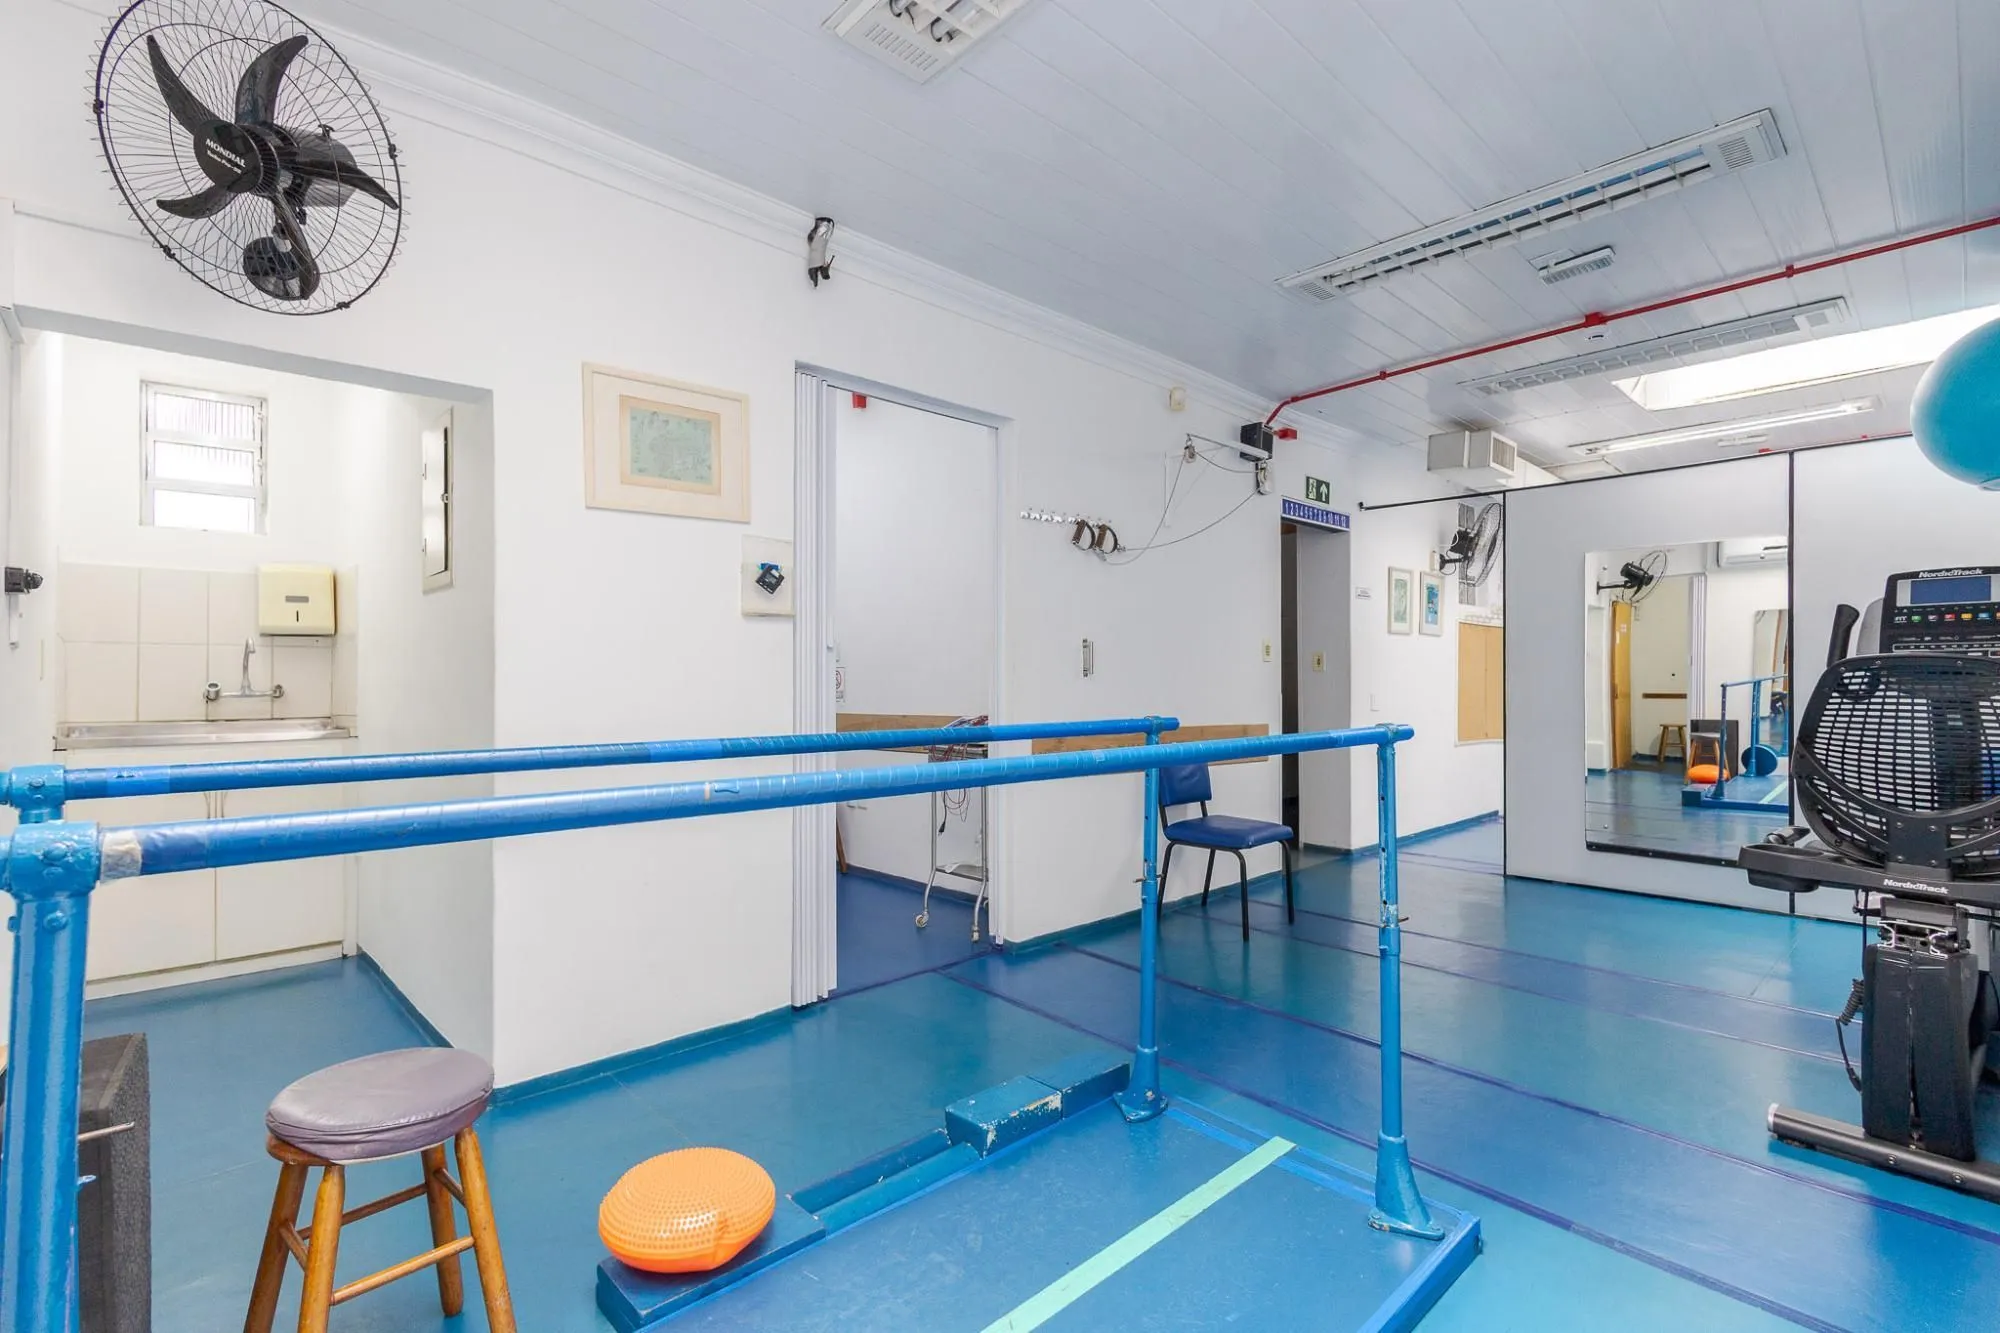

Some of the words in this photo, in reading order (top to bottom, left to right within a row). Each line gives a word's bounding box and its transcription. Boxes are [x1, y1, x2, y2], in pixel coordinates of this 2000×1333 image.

[206, 139, 246, 168] MONDIAL
[1919, 568, 1983, 578] NordicTrack
[1883, 879, 1949, 894] NordicTrack
